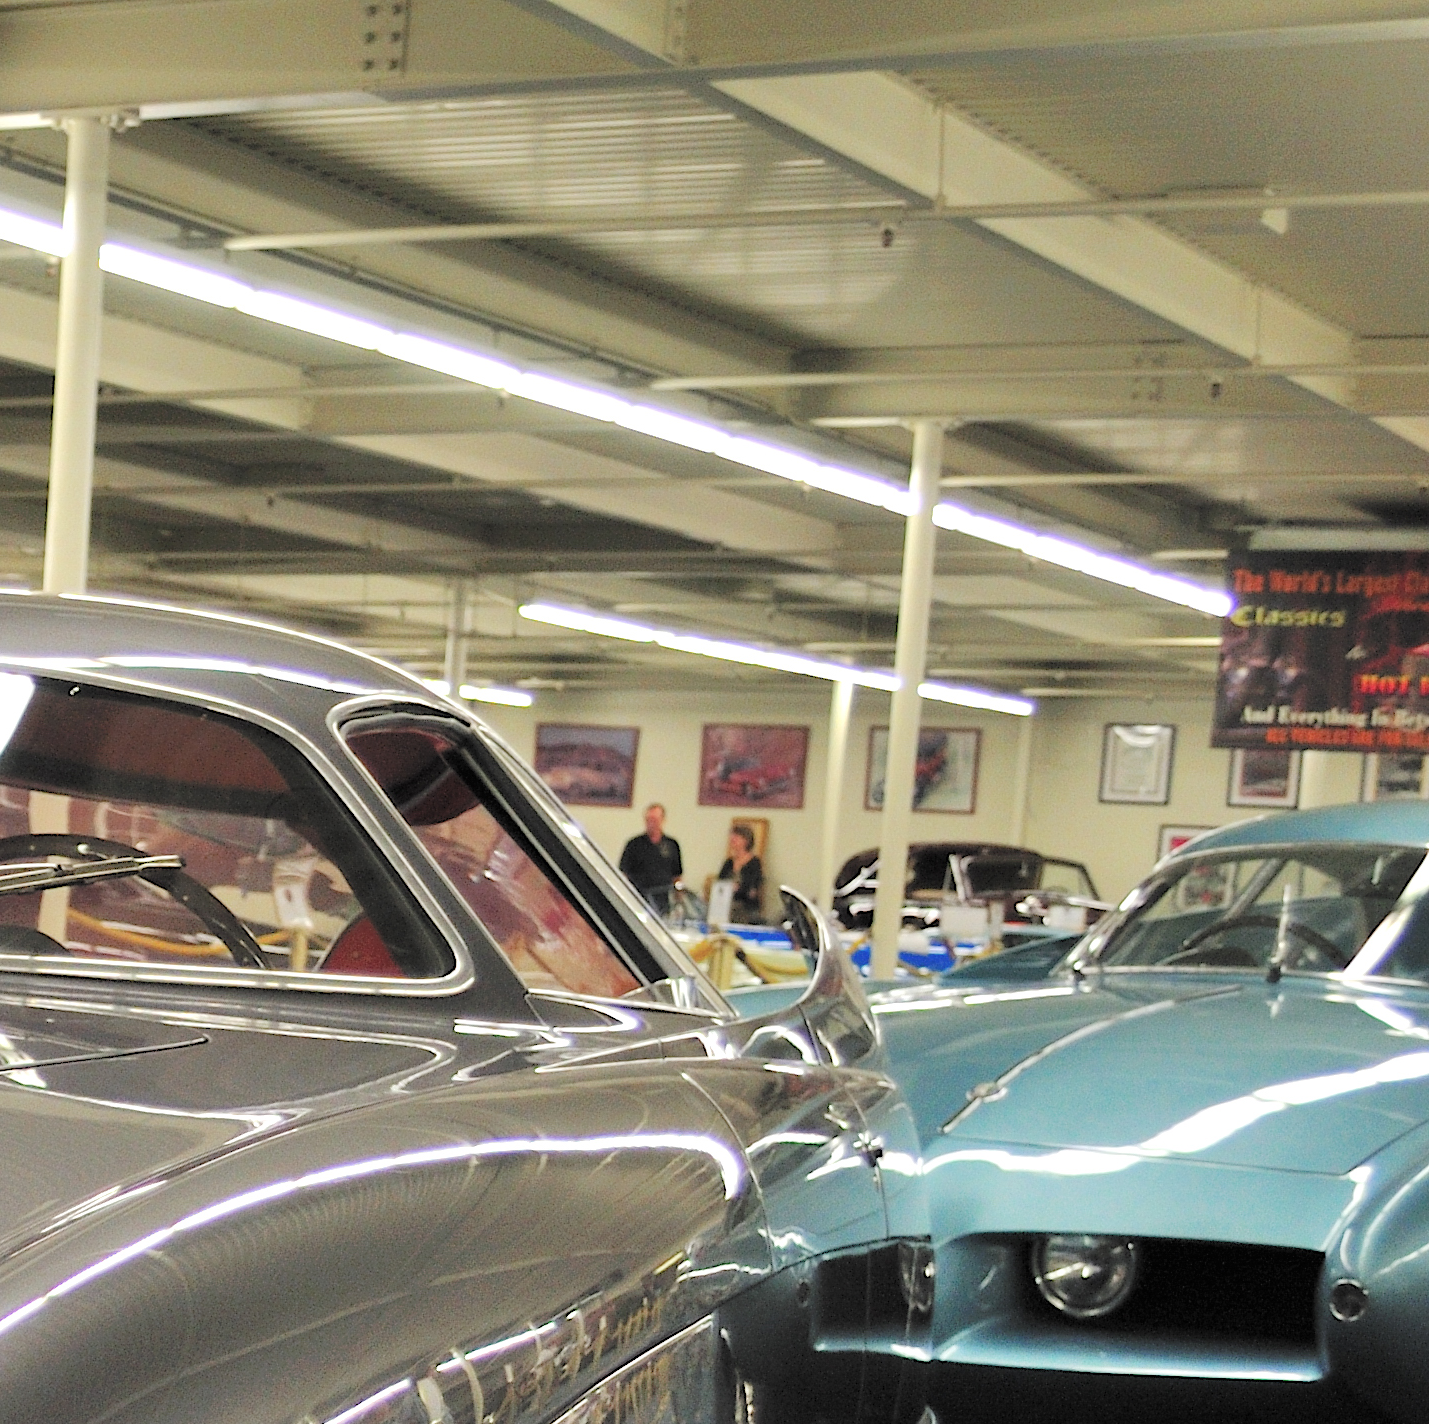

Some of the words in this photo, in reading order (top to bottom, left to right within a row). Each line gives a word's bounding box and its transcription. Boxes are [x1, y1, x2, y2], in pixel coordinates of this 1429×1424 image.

[1233, 568, 1264, 593] The
[1269, 569, 1331, 594] World's
[1231, 605, 1347, 628] Classics
[1242, 704, 1276, 724] And
[1278, 705, 1368, 730] Everything
